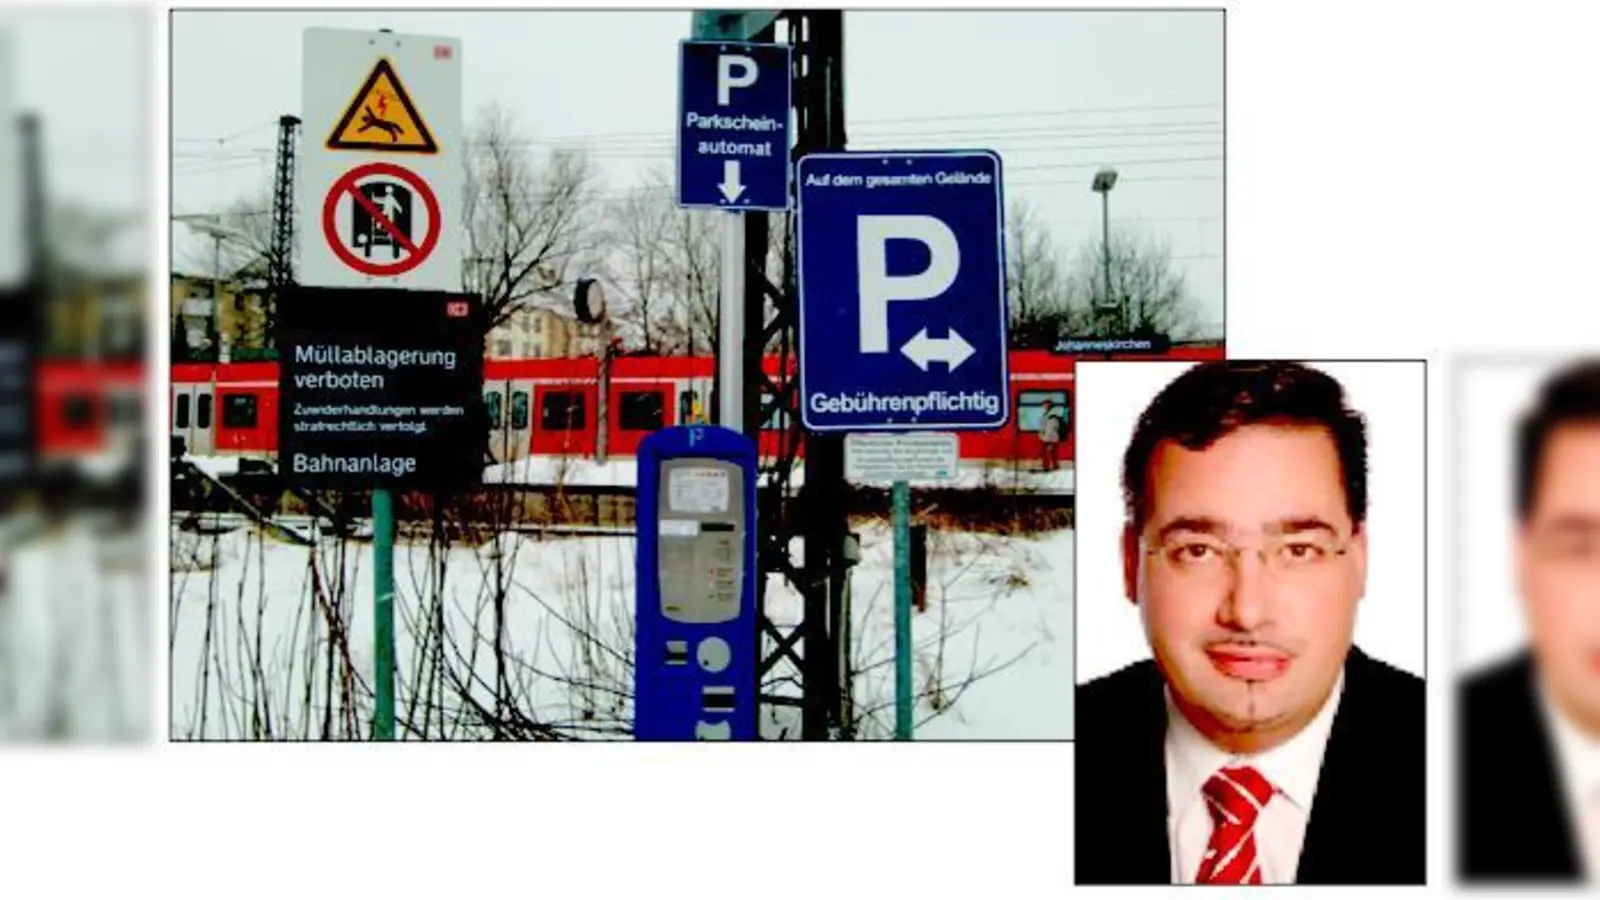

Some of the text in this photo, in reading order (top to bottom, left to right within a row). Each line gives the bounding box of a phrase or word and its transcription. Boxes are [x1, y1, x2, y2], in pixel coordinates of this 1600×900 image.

[717, 55, 758, 105] P
[686, 111, 783, 132] Parkschein-
[698, 140, 772, 157] automat
[805, 171, 992, 188] Auf dem gesamten Gelände
[857, 214, 961, 353] P
[294, 345, 457, 369] Müllablagerung
[294, 371, 385, 390] verboten
[419, 404, 464, 416] werden
[810, 391, 999, 415] Gebührenpflichtig
[292, 453, 417, 477] Bahnanlage
